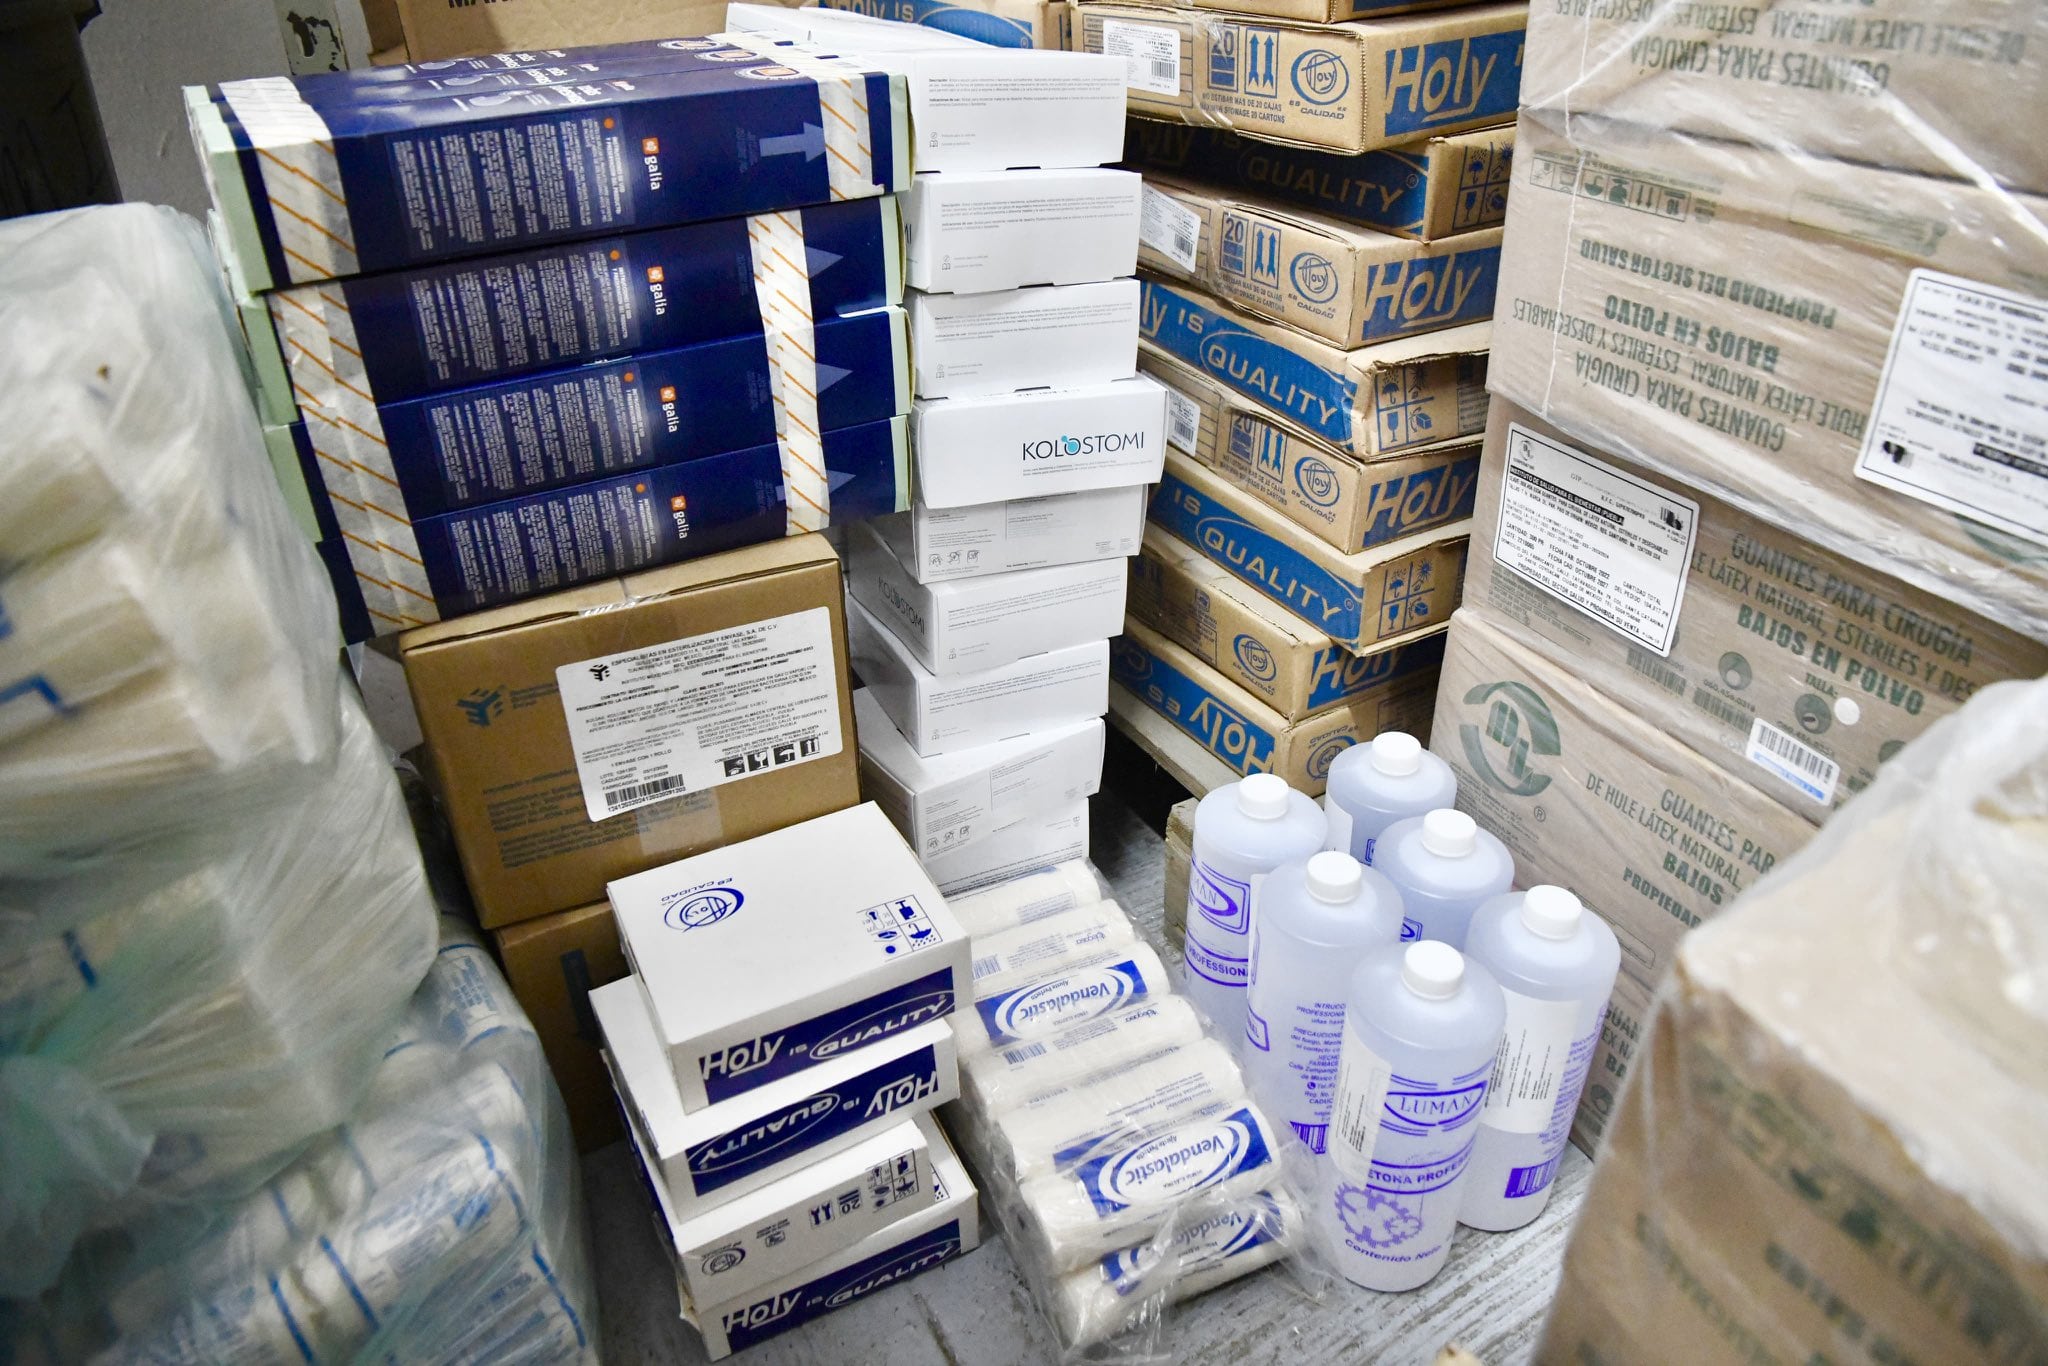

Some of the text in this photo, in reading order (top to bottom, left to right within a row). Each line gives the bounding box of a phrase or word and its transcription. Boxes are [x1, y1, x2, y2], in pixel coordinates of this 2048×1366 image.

[1386, 37, 1498, 122] Holy
[1716, 42, 1772, 81] PARA
[1264, 102, 1282, 112] CAJAS
[1300, 107, 1345, 120] CALIDAD
[643, 154, 664, 190] galia
[1250, 154, 1406, 213] QUALITY
[1224, 217, 1245, 244] 20
[649, 282, 668, 316] galia
[1366, 252, 1482, 328] Holy
[1580, 237, 1838, 330] PROPIEDAD DEL SECTOR SALUD
[1297, 301, 1335, 320] CALIDAD
[1512, 296, 1596, 343] DESECHABLES
[1603, 294, 1671, 333] POLVO
[1595, 326, 1608, 349] Y
[1705, 323, 1782, 376] BAJOS
[1177, 311, 1204, 333] IS
[1207, 343, 1338, 425] QUALITY
[661, 401, 680, 433] galia
[1574, 350, 1787, 453] GUANTES PARA CIRUGÍA
[1022, 431, 1145, 461] KOLOSTOMI
[672, 510, 690, 539] galia
[1299, 499, 1335, 525] CALIDAD
[1366, 468, 1478, 533] Holy
[1174, 488, 1342, 622] IS QUALITY
[878, 575, 925, 635] KOLOSTOMI
[1709, 556, 1752, 607] LÁTEX
[1922, 655, 1936, 685] Y
[1731, 533, 1974, 667] GUANTES PARA CIRUGÍA
[1738, 603, 1925, 717] BAJOS EN POLVO
[1586, 771, 1605, 797] DE
[1606, 780, 1637, 815] HULE
[1638, 801, 1677, 843] LÁTEX
[1661, 790, 1737, 858] GUANTES
[1662, 851, 1725, 908] BAJOS
[1019, 980, 1112, 1023] Vendalastic
[701, 1027, 786, 1080] Holy
[814, 996, 947, 1057] QUALITY
[864, 1070, 940, 1119] Holy
[1400, 1093, 1474, 1116] LUMAN
[701, 1096, 837, 1169] QUALITY
[1119, 1135, 1227, 1184] Vendalastic
[1345, 1237, 1412, 1263] Contenido
[724, 1291, 802, 1335] Holy
[830, 1242, 956, 1304] QUALITY
